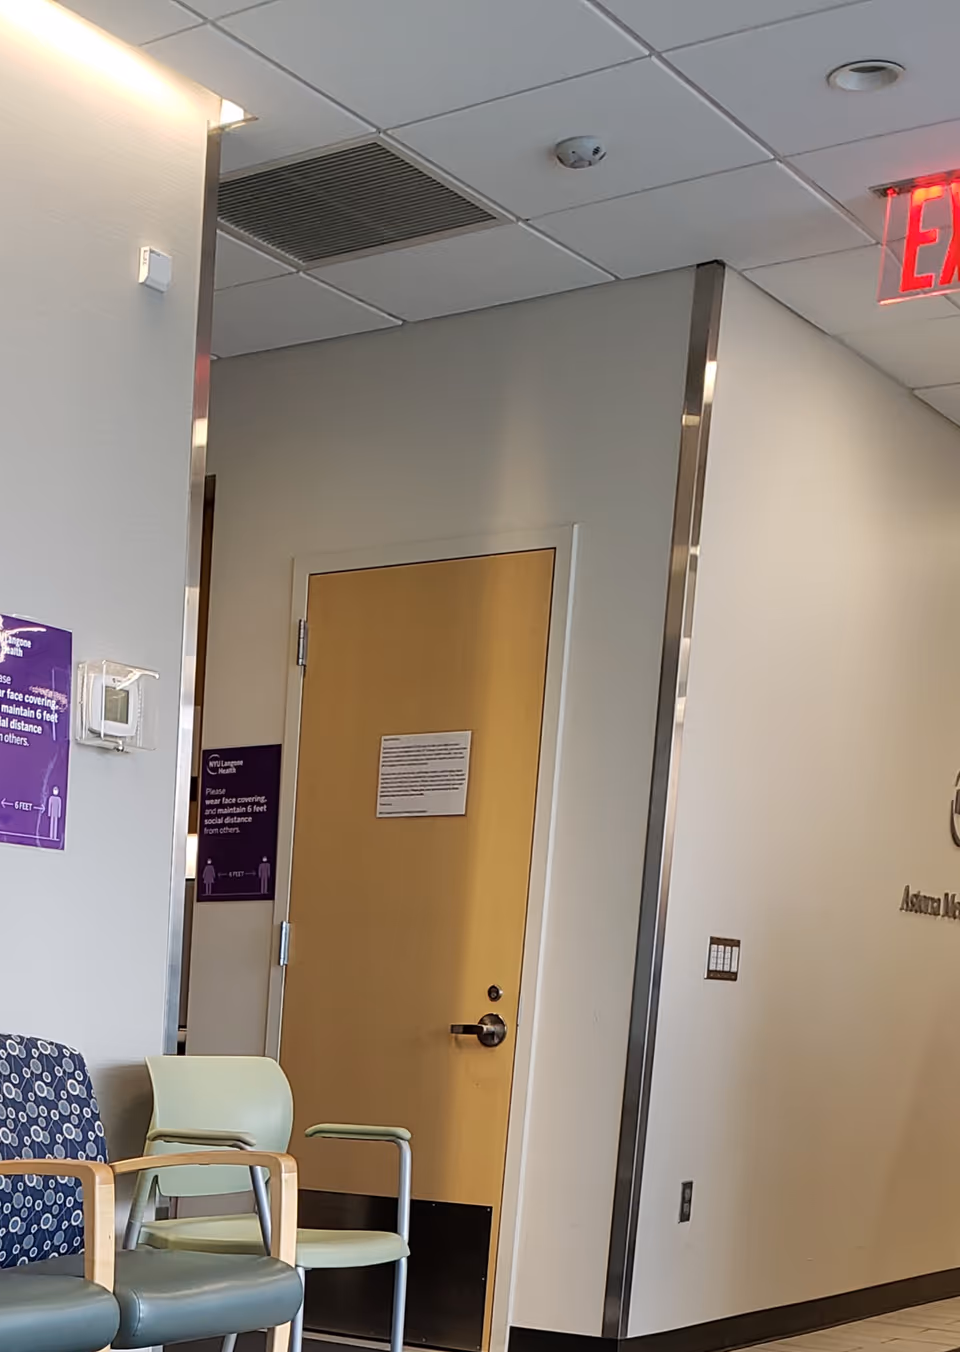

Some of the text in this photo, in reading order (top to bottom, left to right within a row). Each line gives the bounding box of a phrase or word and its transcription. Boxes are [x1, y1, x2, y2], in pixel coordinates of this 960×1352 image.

[7, 689, 24, 701] face
[24, 694, 58, 711] covering,
[1, 704, 35, 718] maintain
[36, 709, 42, 720] 6
[43, 710, 58, 723] feet
[10, 719, 42, 734] distance
[4, 732, 30, 746] others.
[209, 760, 244, 768] NYU Langone
[218, 767, 237, 775] Health
[206, 788, 227, 796] Please
[205, 795, 268, 806] wear face covering,
[14, 801, 33, 811] 6 FEET
[204, 804, 267, 815] and maintain 6 feet
[204, 816, 253, 825] social distance
[204, 826, 241, 835] from others.
